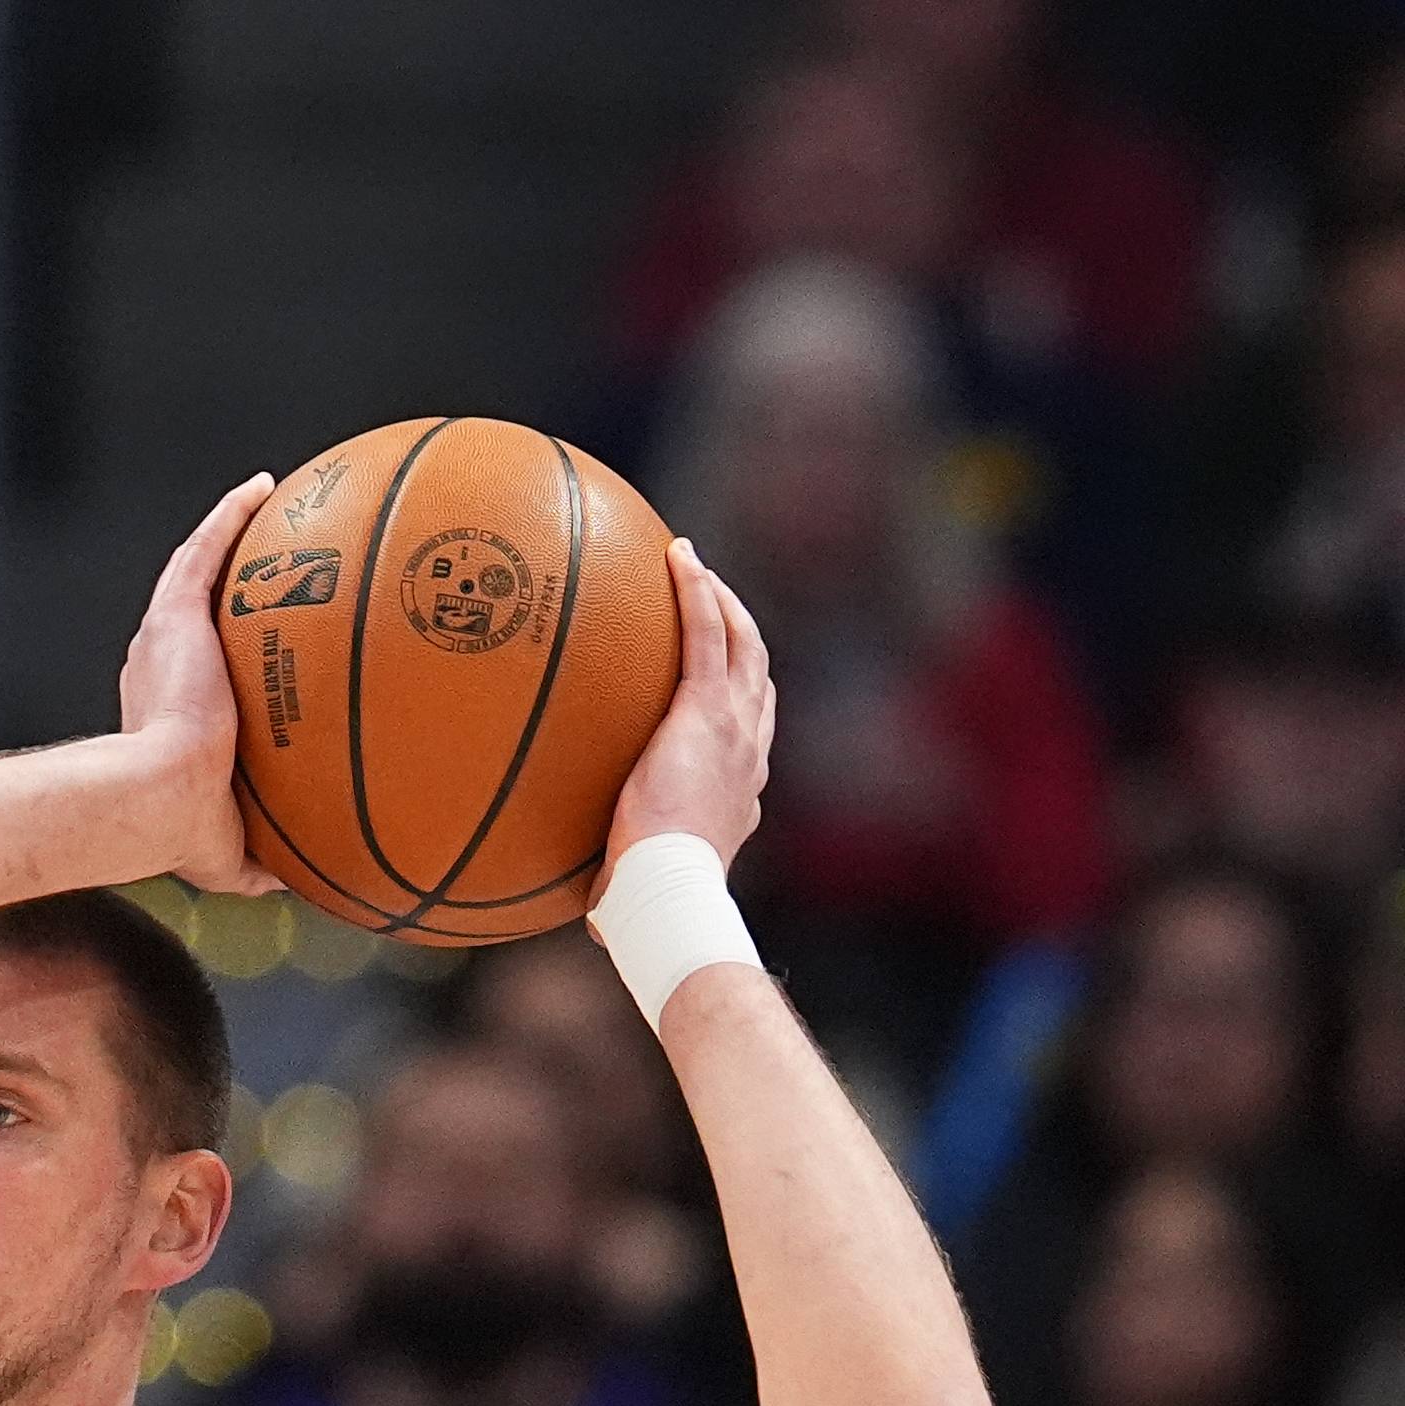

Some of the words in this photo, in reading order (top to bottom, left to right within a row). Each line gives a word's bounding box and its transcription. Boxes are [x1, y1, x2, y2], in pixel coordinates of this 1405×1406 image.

[263, 628, 279, 656] BALL
[264, 658, 280, 692] GAME
[266, 694, 290, 747] OFFICIAL
